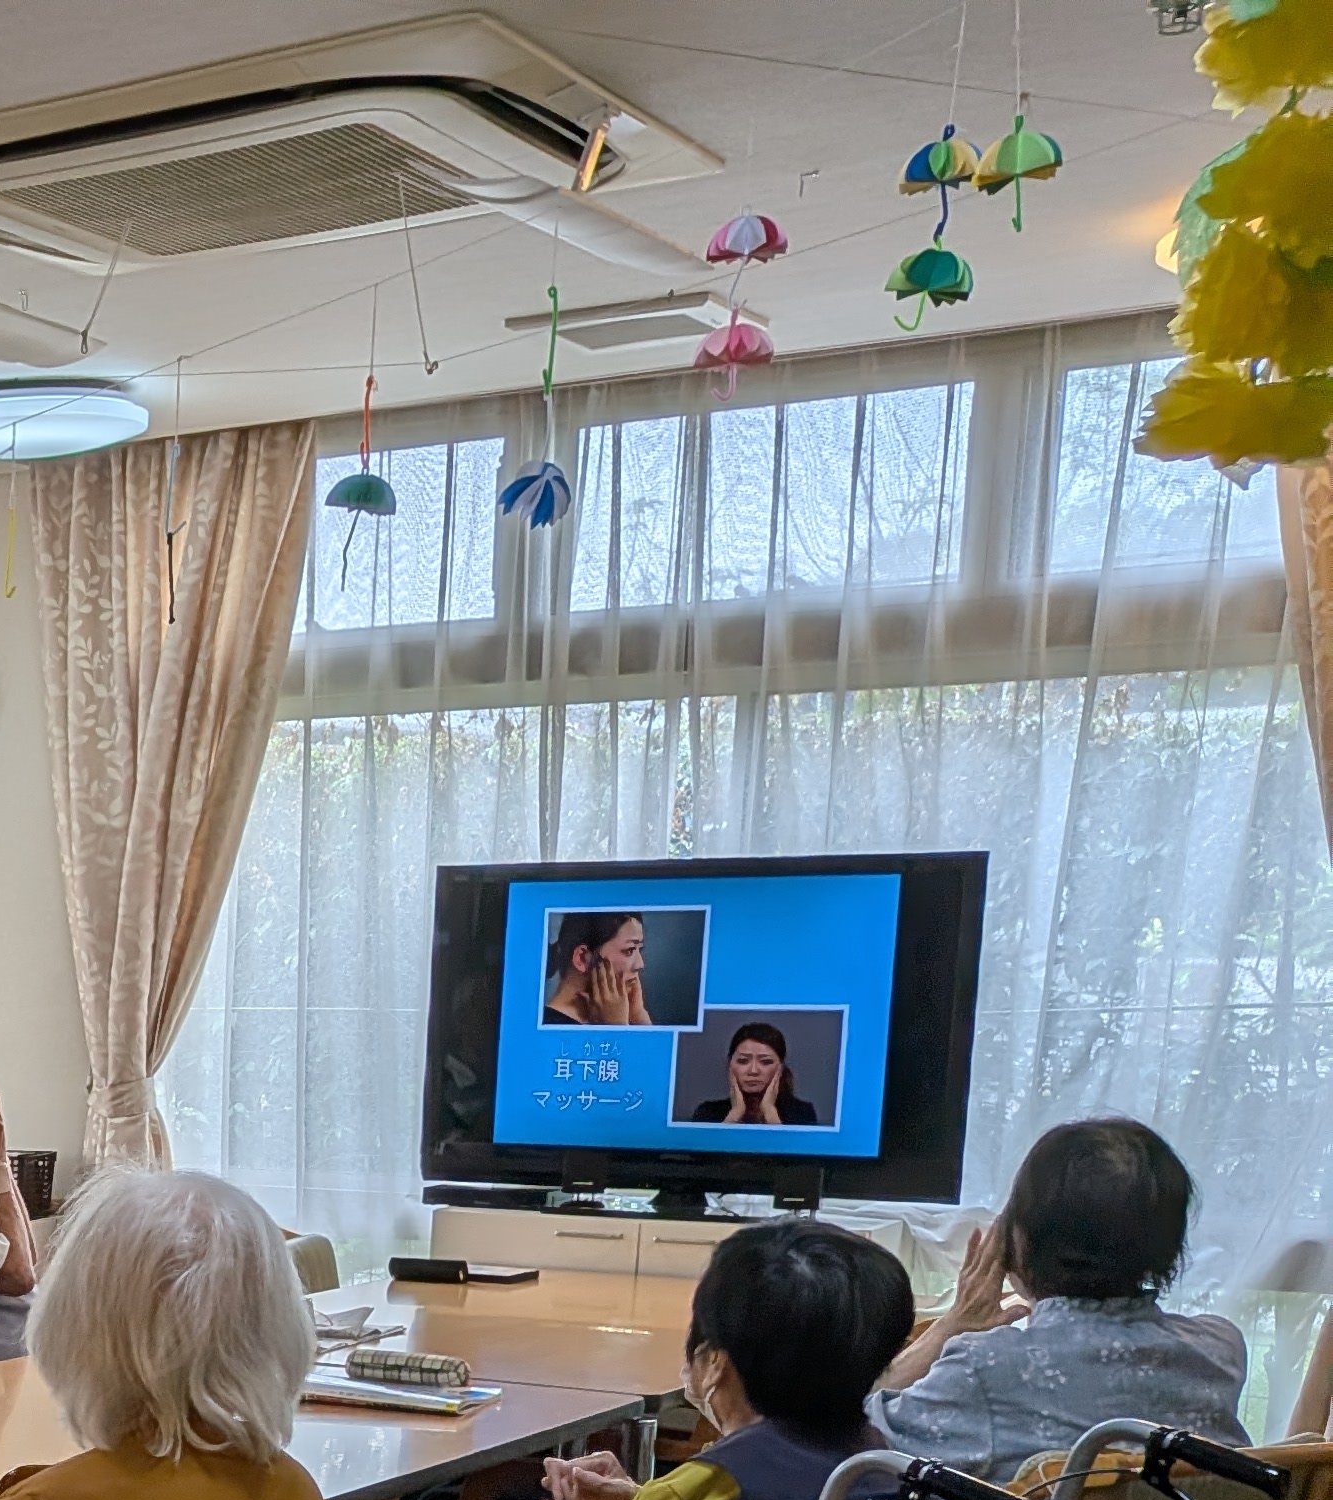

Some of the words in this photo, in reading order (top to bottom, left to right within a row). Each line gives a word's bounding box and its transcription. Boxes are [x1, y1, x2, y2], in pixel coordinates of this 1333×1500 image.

[561, 1041, 622, 1056] しかせん
[553, 1058, 619, 1082] 耳下腺
[532, 1090, 643, 1112] マッサージ
